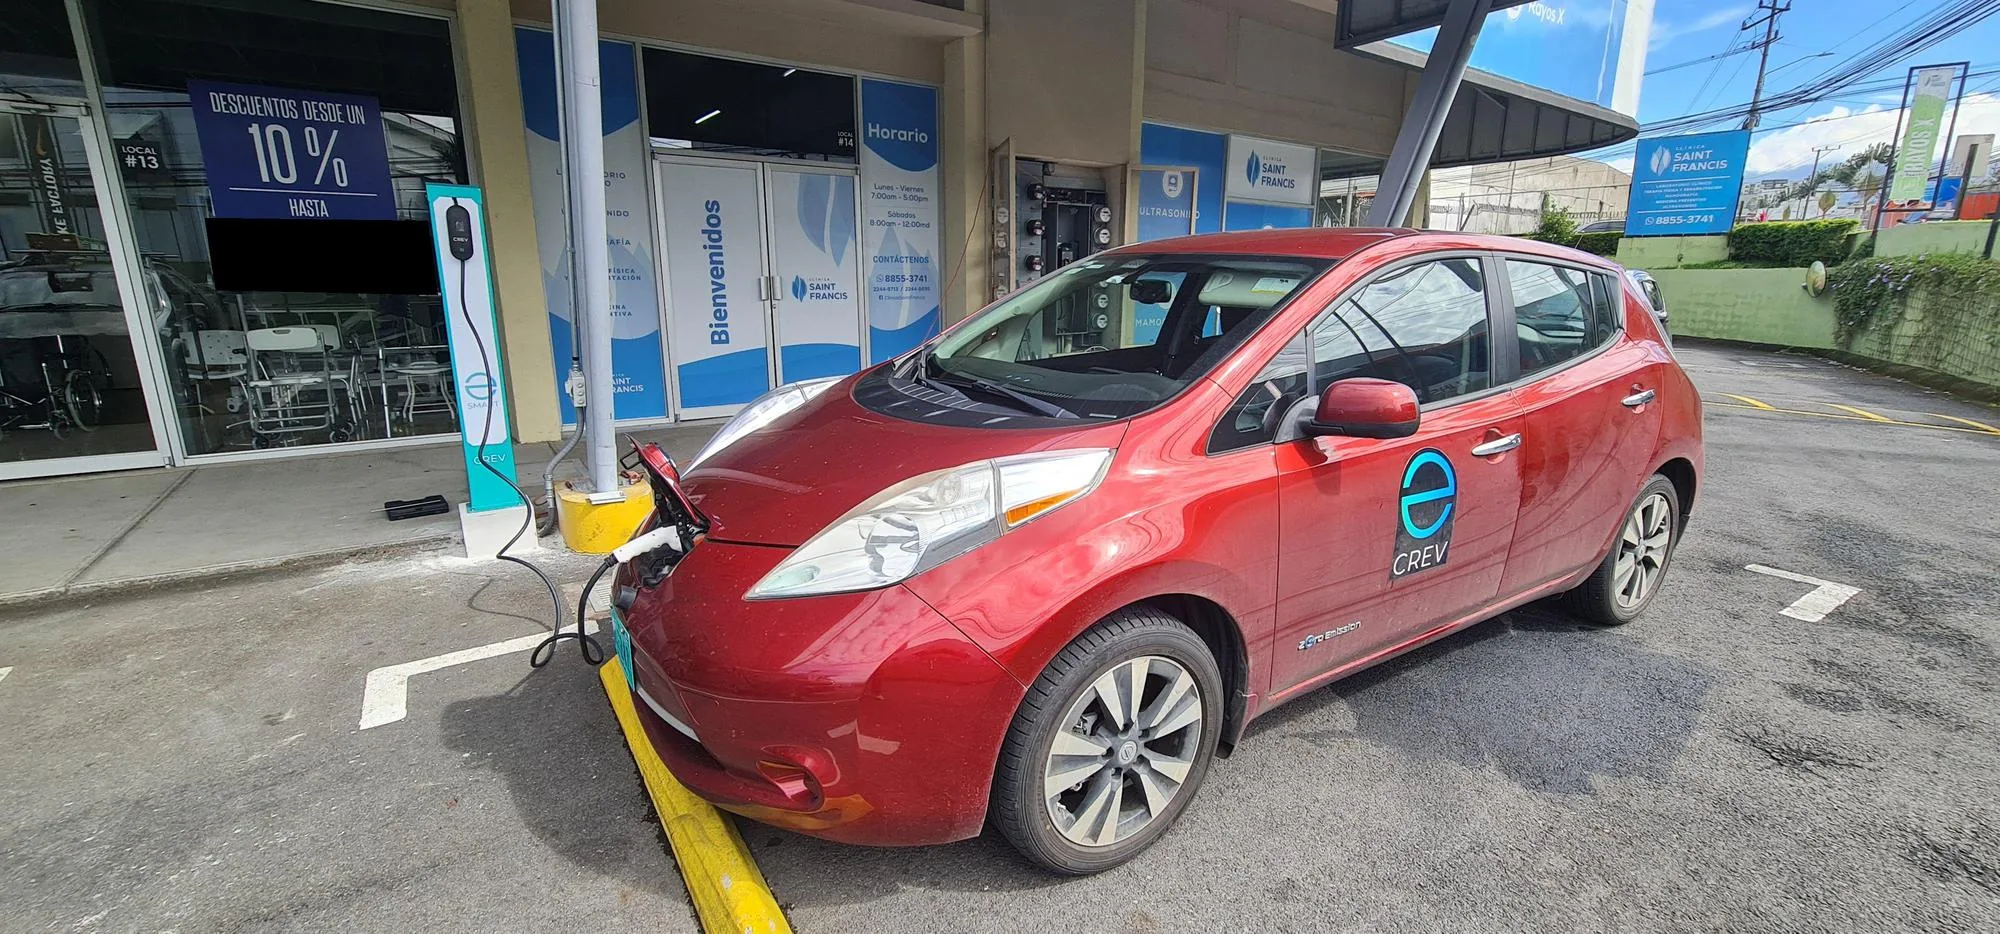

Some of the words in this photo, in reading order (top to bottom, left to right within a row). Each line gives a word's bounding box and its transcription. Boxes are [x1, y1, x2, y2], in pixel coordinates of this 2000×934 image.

[1528, 1, 1556, 22] Rayos
[1557, 7, 1566, 24] X
[209, 92, 299, 119] DESCUENTOS
[302, 100, 345, 124] DESDE
[345, 104, 366, 125] UN
[868, 122, 929, 144] Horario
[838, 137, 854, 147] #14
[121, 145, 157, 155] LOCAL
[248, 123, 298, 184] 10
[304, 126, 349, 187] %
[1673, 150, 1713, 162] SAINT
[125, 154, 159, 169] #13
[1672, 159, 1729, 172] FRANCIS
[1262, 163, 1287, 175] SAINT
[1261, 176, 1296, 189] FRANCIS
[874, 183, 894, 191] Lunes
[899, 184, 924, 193] Viernes
[871, 192, 897, 200] 7:00am
[903, 194, 929, 202] 5:00pm
[289, 199, 329, 218] HASTA
[1139, 207, 1200, 219] ULTRASONIO
[887, 210, 916, 219] Sábados
[869, 219, 897, 227] 8:00am
[1655, 215, 1714, 225] 8855-3741
[872, 254, 930, 264] CONTÁCTENOS
[701, 200, 730, 345] Bienvenidos
[885, 274, 928, 283] 8855-3741
[809, 282, 836, 291] SAINT
[809, 292, 848, 300] FRANCIS
[611, 377, 632, 385] AINT
[612, 384, 645, 393] RANCIS
[467, 400, 500, 410] SMAT
[1392, 540, 1449, 576] CREV
